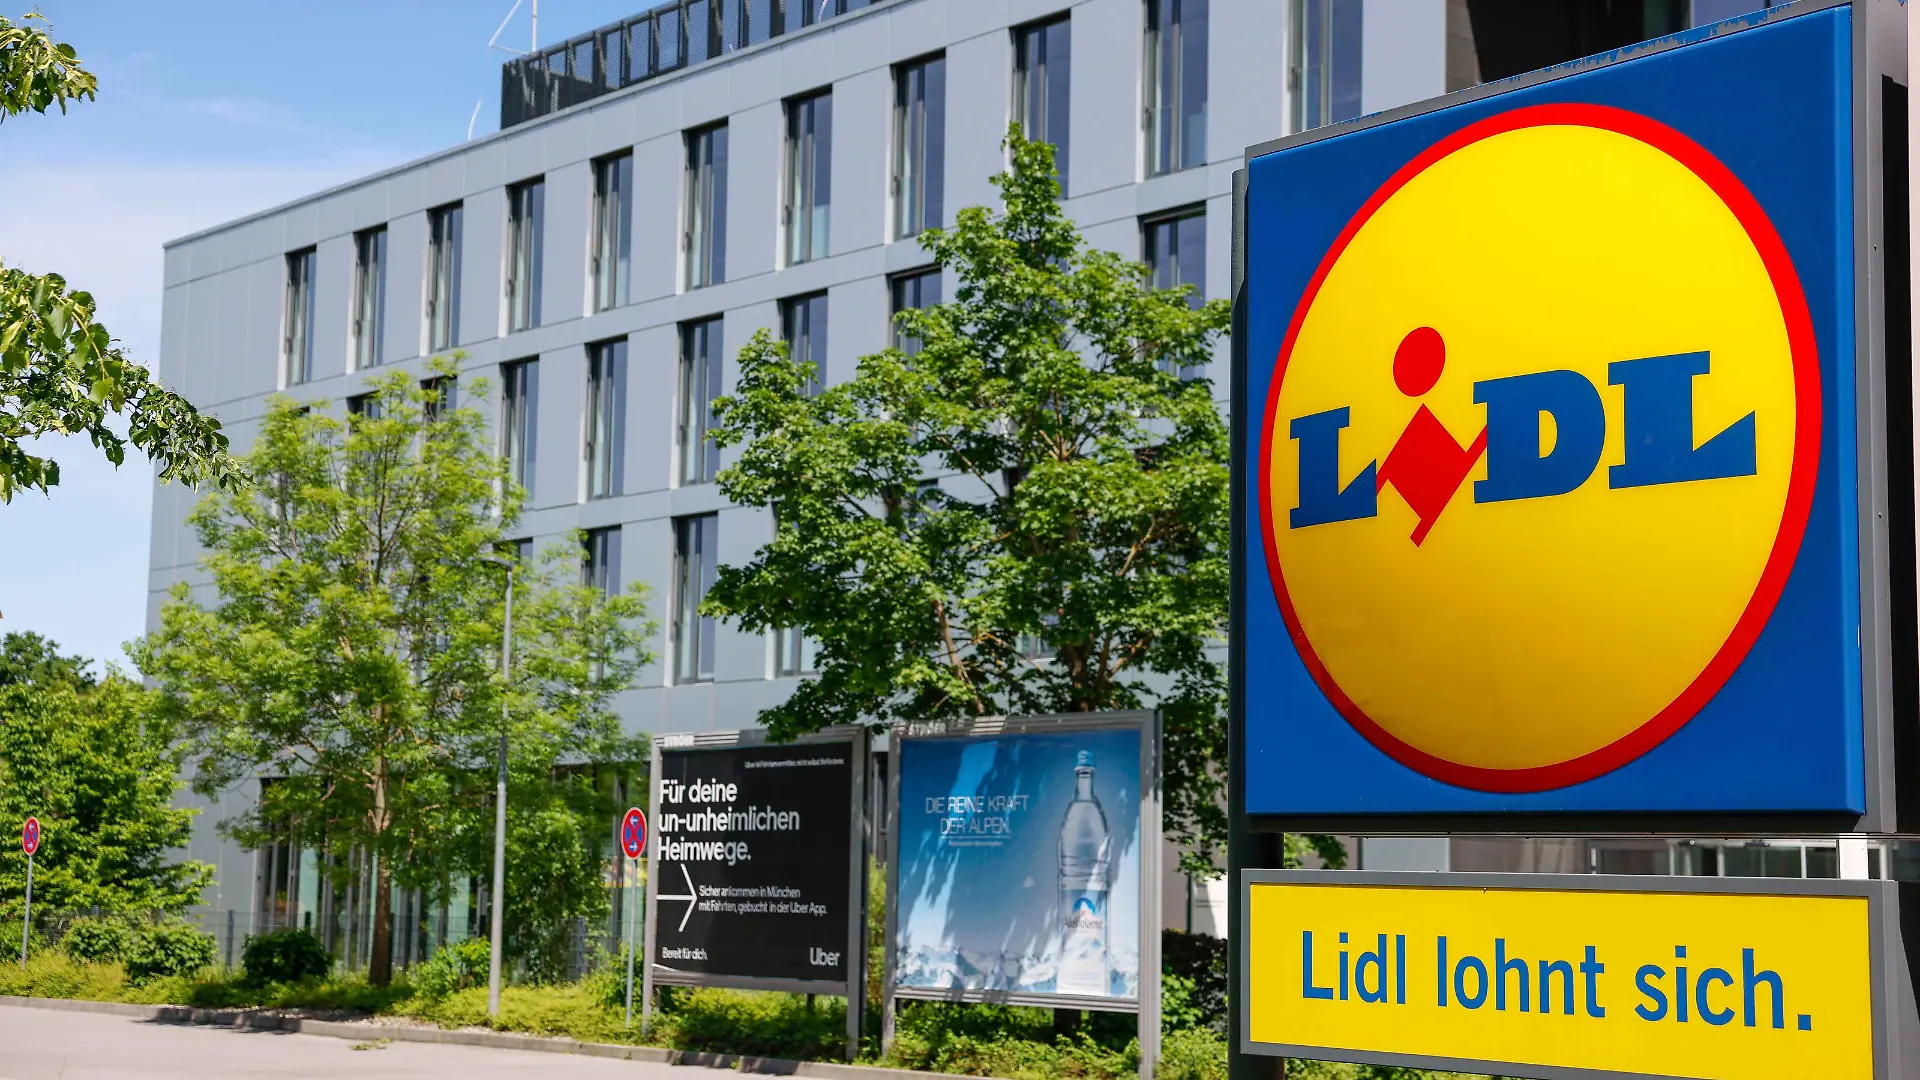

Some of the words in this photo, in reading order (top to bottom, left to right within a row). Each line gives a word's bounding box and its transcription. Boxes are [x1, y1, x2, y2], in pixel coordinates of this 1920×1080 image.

[659, 779, 686, 804] Für
[688, 778, 738, 803] deine
[925, 796, 945, 814] DIE
[947, 796, 985, 814] REINE
[987, 795, 1029, 812] KRAFT
[658, 805, 800, 832] un-unheimlichen
[940, 817, 966, 835] DER
[657, 836, 751, 866] Heimwege.
[698, 884, 720, 897] Sicher
[720, 886, 759, 898] ankommen
[760, 886, 767, 898] in
[766, 886, 801, 898] München
[698, 901, 711, 912] mit
[739, 901, 768, 916] gebucht
[769, 902, 777, 913] in
[777, 902, 790, 914] der
[790, 902, 809, 914] Uber
[810, 947, 840, 966] Uber
[1302, 930, 1407, 1005] Lidl
[1437, 934, 1605, 1018] lohnt
[1634, 945, 1813, 1032] sich.
